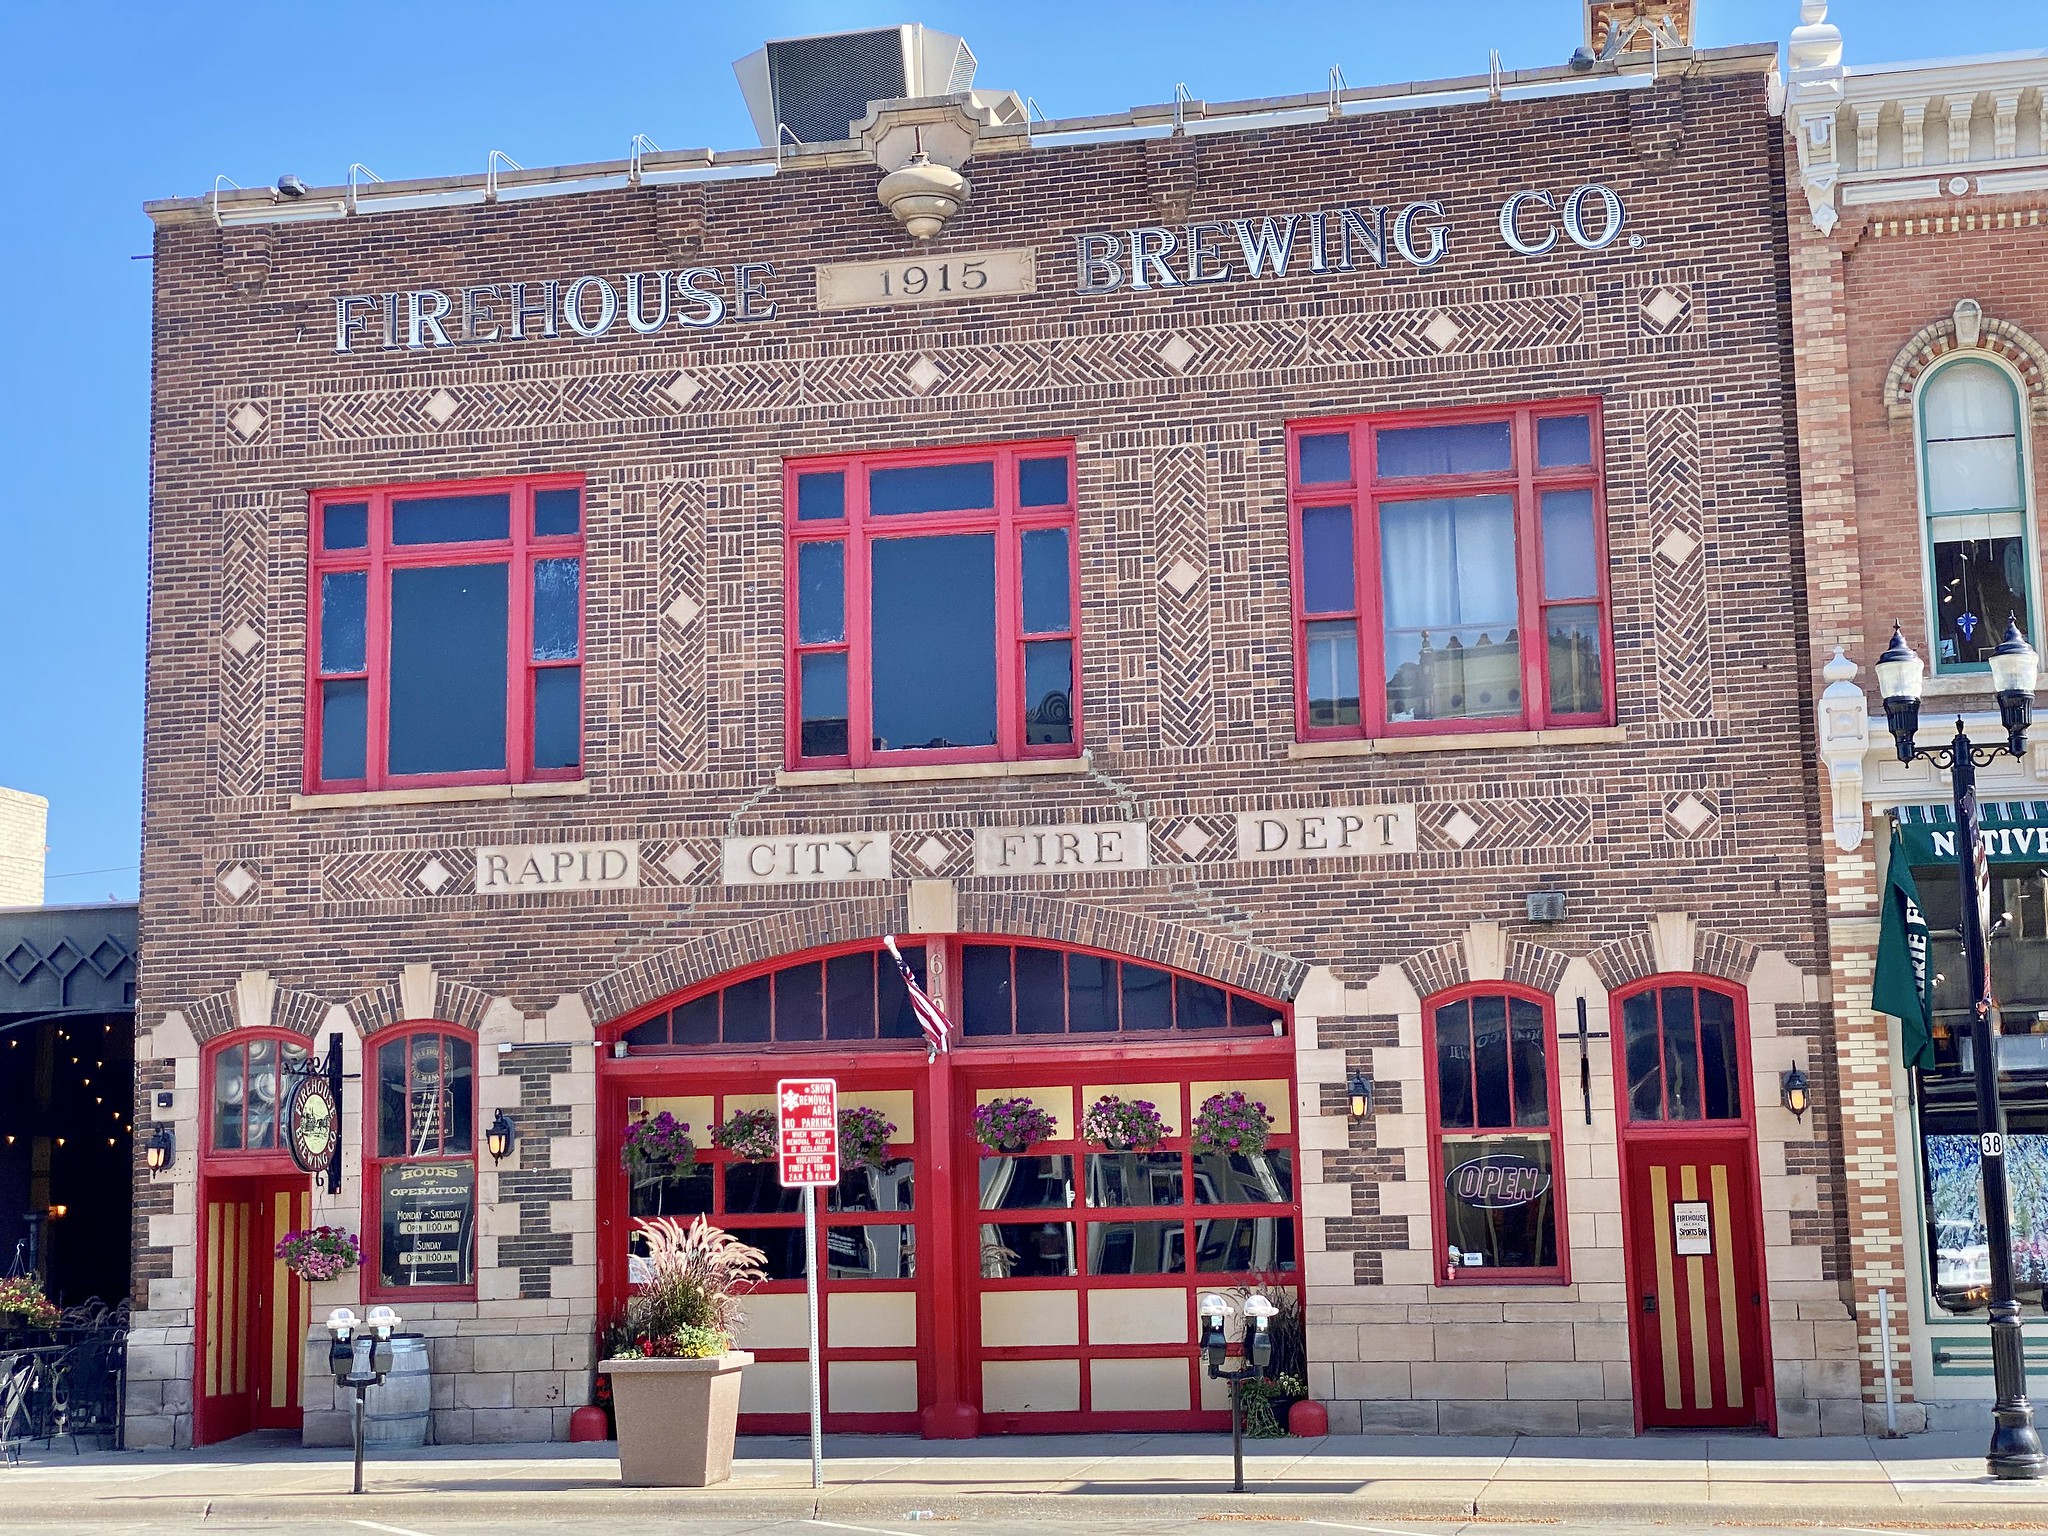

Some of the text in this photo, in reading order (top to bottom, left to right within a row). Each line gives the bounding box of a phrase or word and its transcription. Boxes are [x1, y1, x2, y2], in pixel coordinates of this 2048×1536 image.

[334, 183, 1647, 356] FIREHOUSE BREWING CO.
[879, 259, 988, 297] 1915
[1931, 828, 2048, 856] NTIVE
[485, 812, 1399, 886] RAPID CITY FIRE DEPT
[810, 1084, 831, 1094] SNOW
[295, 1079, 337, 1119] FIREHOUSE
[799, 1095, 832, 1106] REMOVAL
[812, 1106, 832, 1116] AREA
[785, 1118, 833, 1128] NO PARKING
[810, 1130, 826, 1138] SNOW
[786, 1137, 831, 1146] REMOVAL ALERT
[1983, 1135, 2001, 1153] 38
[295, 1126, 328, 1169] BREWING
[800, 1145, 827, 1153] DECLARED
[796, 1156, 823, 1164] VIOLATORS
[788, 1164, 804, 1172] FINED
[814, 1163, 831, 1172] TOWED
[401, 1167, 458, 1180] HOURS
[1458, 1165, 1539, 1200] OPEN
[390, 1186, 469, 1197] OPERATION
[1676, 1214, 1707, 1222] FIREHOUSE
[426, 1222, 442, 1232] 11:00
[444, 1223, 453, 1231] AM
[1698, 1227, 1708, 1236] BAR
[426, 1252, 442, 1262] 11:00
[444, 1253, 453, 1261] AM
